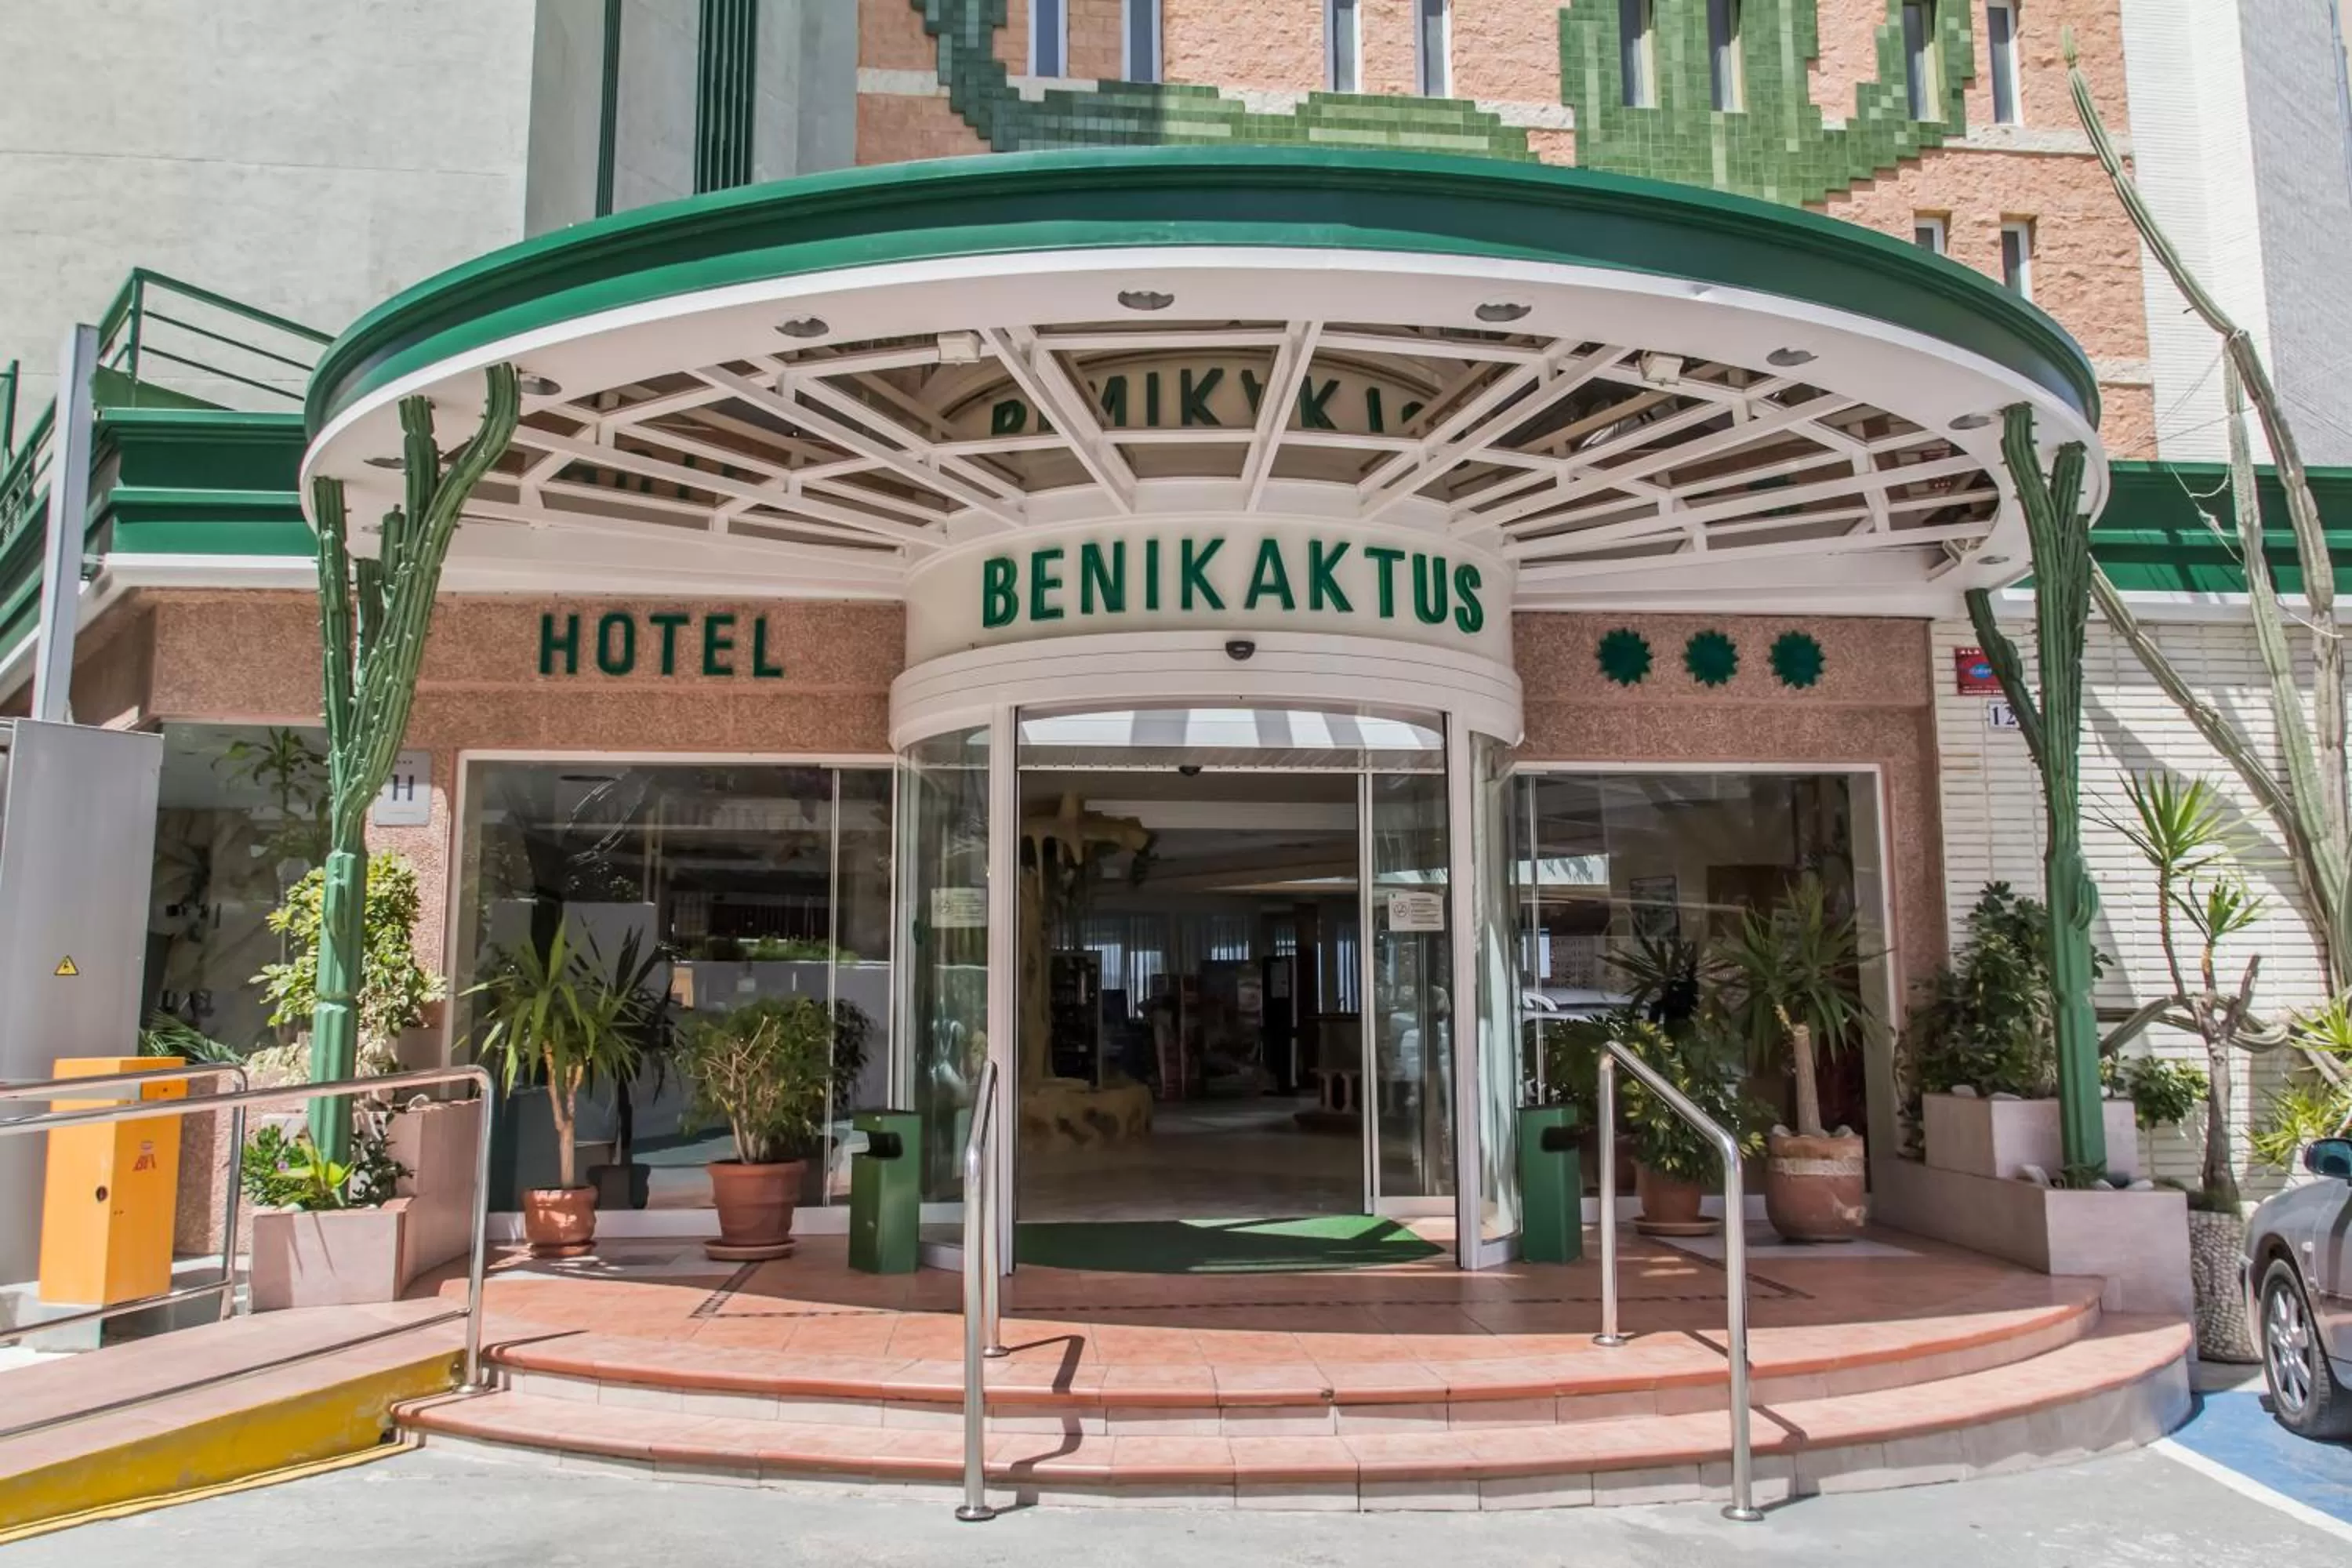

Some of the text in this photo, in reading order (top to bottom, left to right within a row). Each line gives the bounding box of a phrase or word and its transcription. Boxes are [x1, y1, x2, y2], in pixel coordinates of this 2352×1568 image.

[982, 538, 1483, 633] BENIKAKTUS
[539, 612, 784, 677] HOTEL
[392, 774, 414, 801] H
